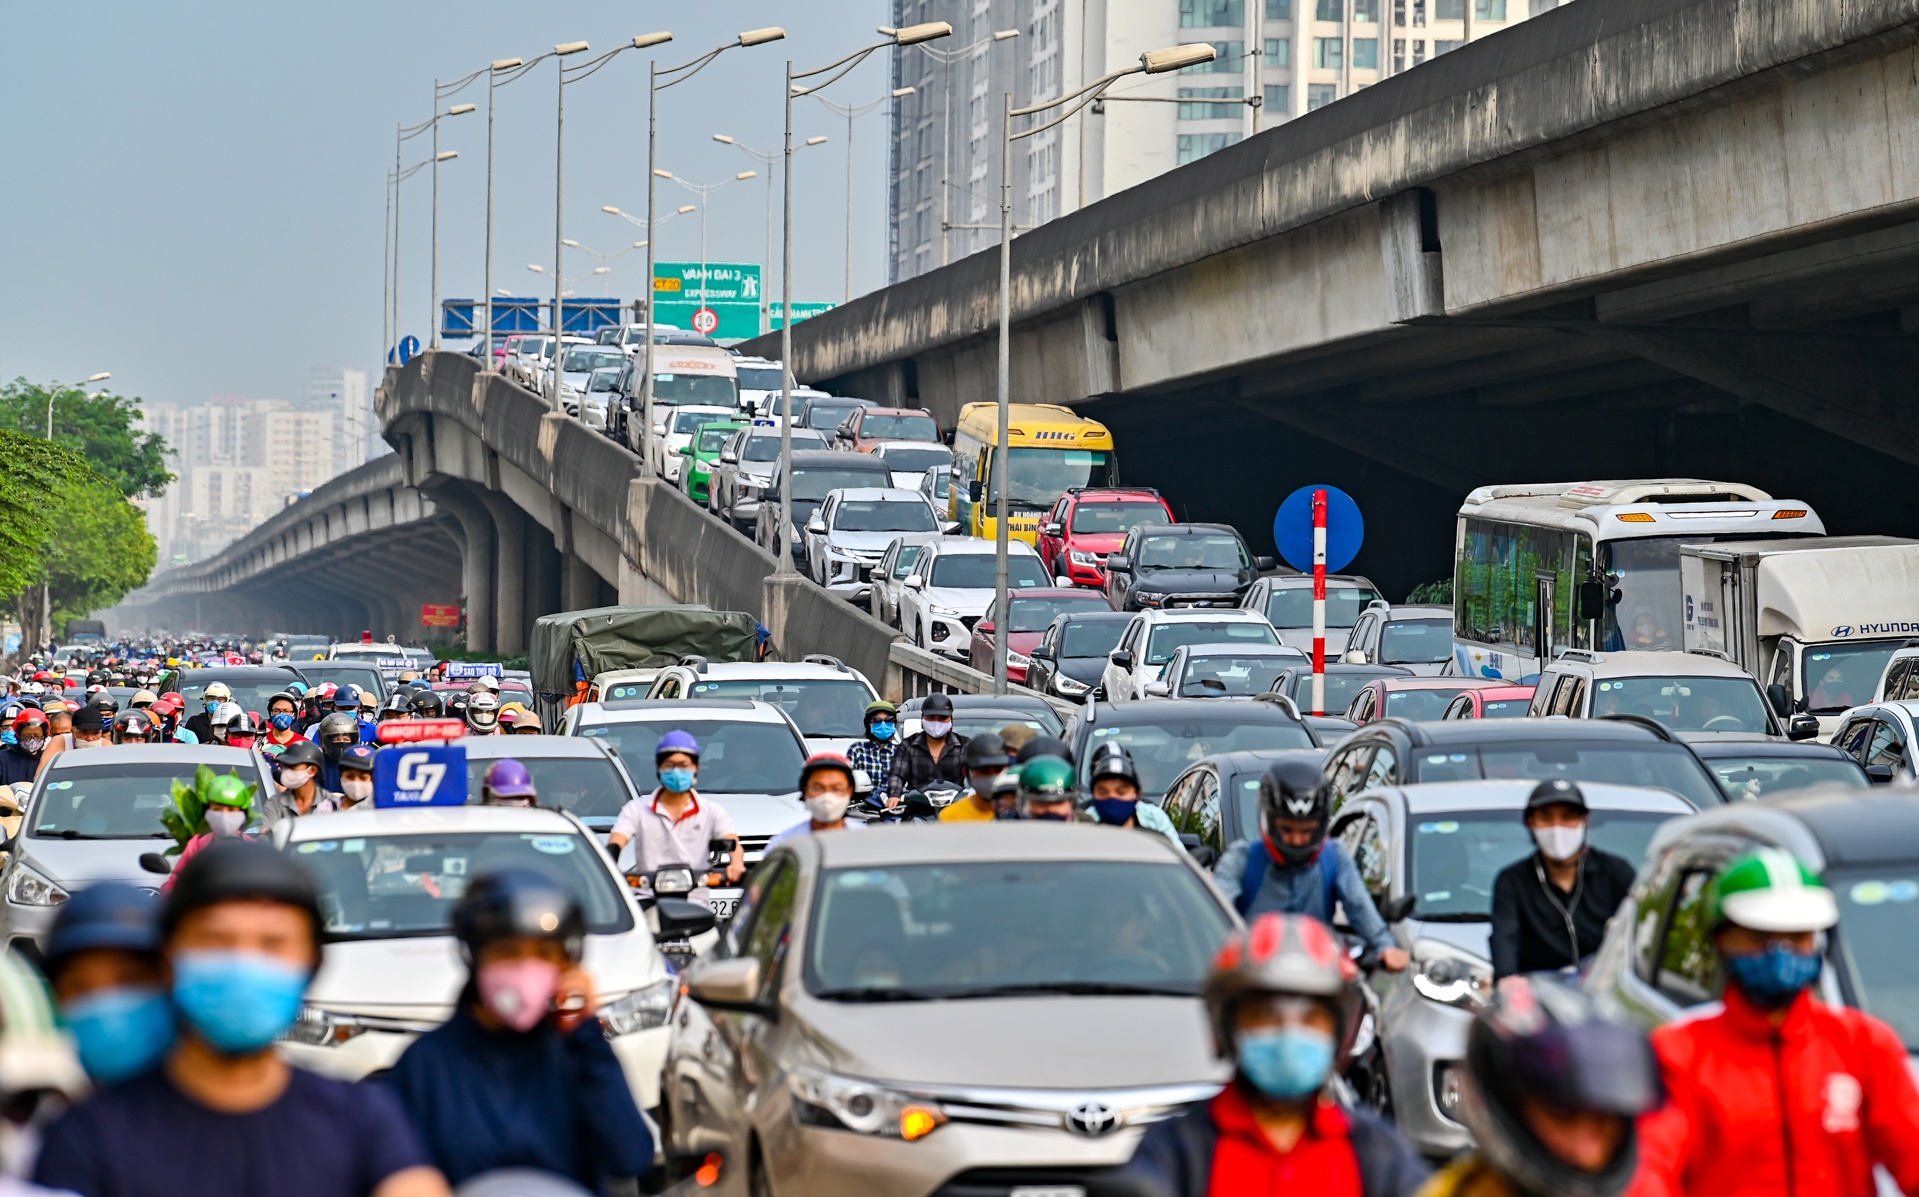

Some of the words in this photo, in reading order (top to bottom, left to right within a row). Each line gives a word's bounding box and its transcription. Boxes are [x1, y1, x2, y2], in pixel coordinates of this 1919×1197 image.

[734, 270, 741, 281] 3
[684, 288, 737, 298] EXPESSWAY
[1035, 431, 1075, 440] HHG
[1024, 523, 1037, 532] BÌN
[1859, 622, 1919, 634] HYUNDA
[463, 667, 475, 676] SAO
[396, 752, 447, 802] G7
